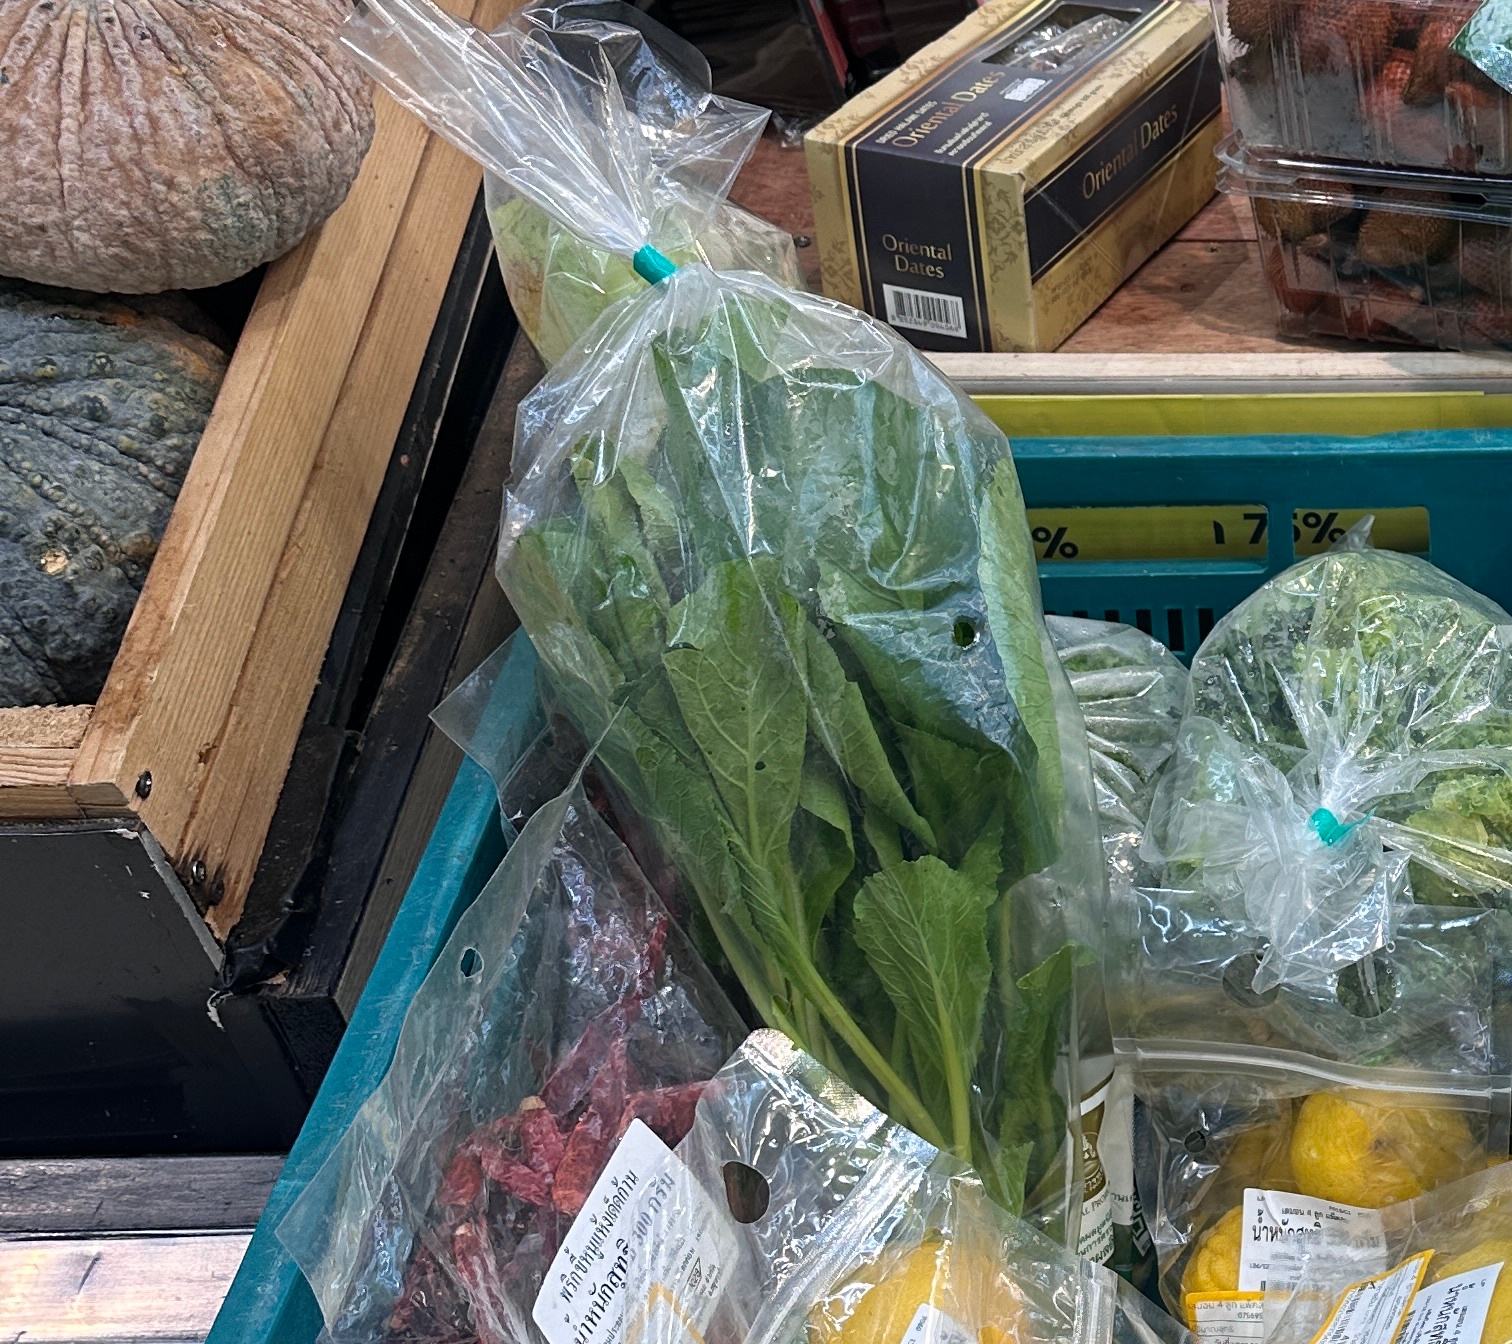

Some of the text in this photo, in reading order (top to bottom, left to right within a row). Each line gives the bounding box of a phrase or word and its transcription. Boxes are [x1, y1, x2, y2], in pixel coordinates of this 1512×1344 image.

[892, 102, 964, 147] Oriental
[951, 71, 1006, 102] Dates
[1082, 133, 1139, 200] Oriental
[1140, 103, 1178, 149] Dates
[882, 234, 952, 262] Oriental
[894, 254, 945, 279] Dates
